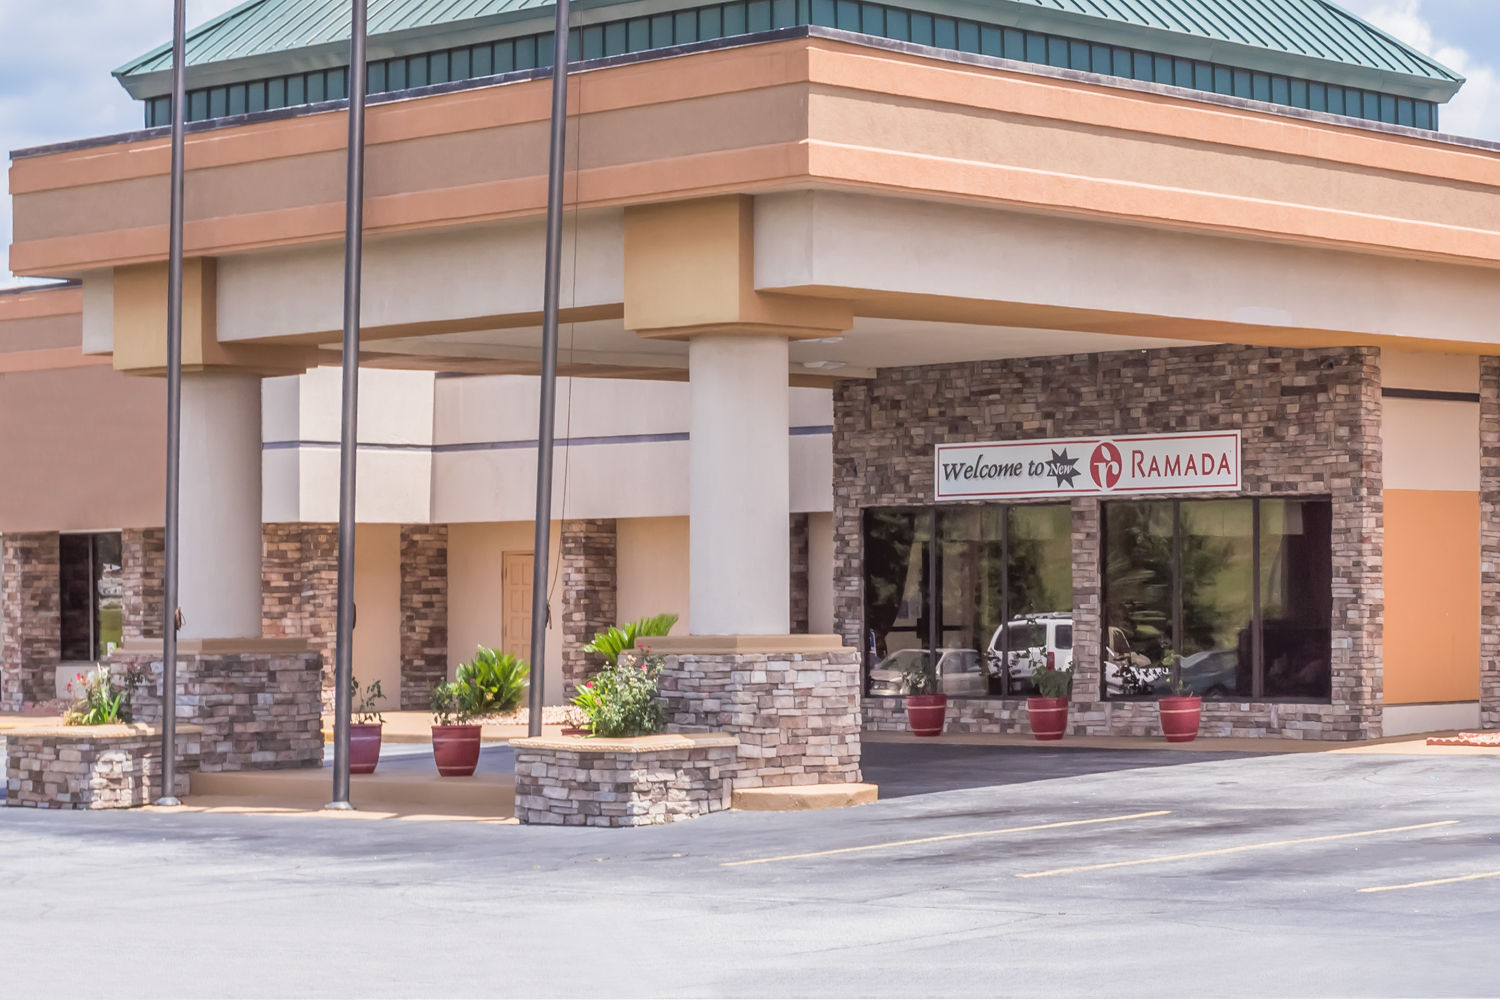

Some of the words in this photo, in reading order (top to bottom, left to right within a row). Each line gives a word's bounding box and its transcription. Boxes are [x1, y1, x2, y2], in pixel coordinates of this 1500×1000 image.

[942, 453, 1023, 480] Welcome
[1028, 460, 1045, 477] to
[1049, 462, 1074, 476] New
[1131, 450, 1231, 479] RAMADA
